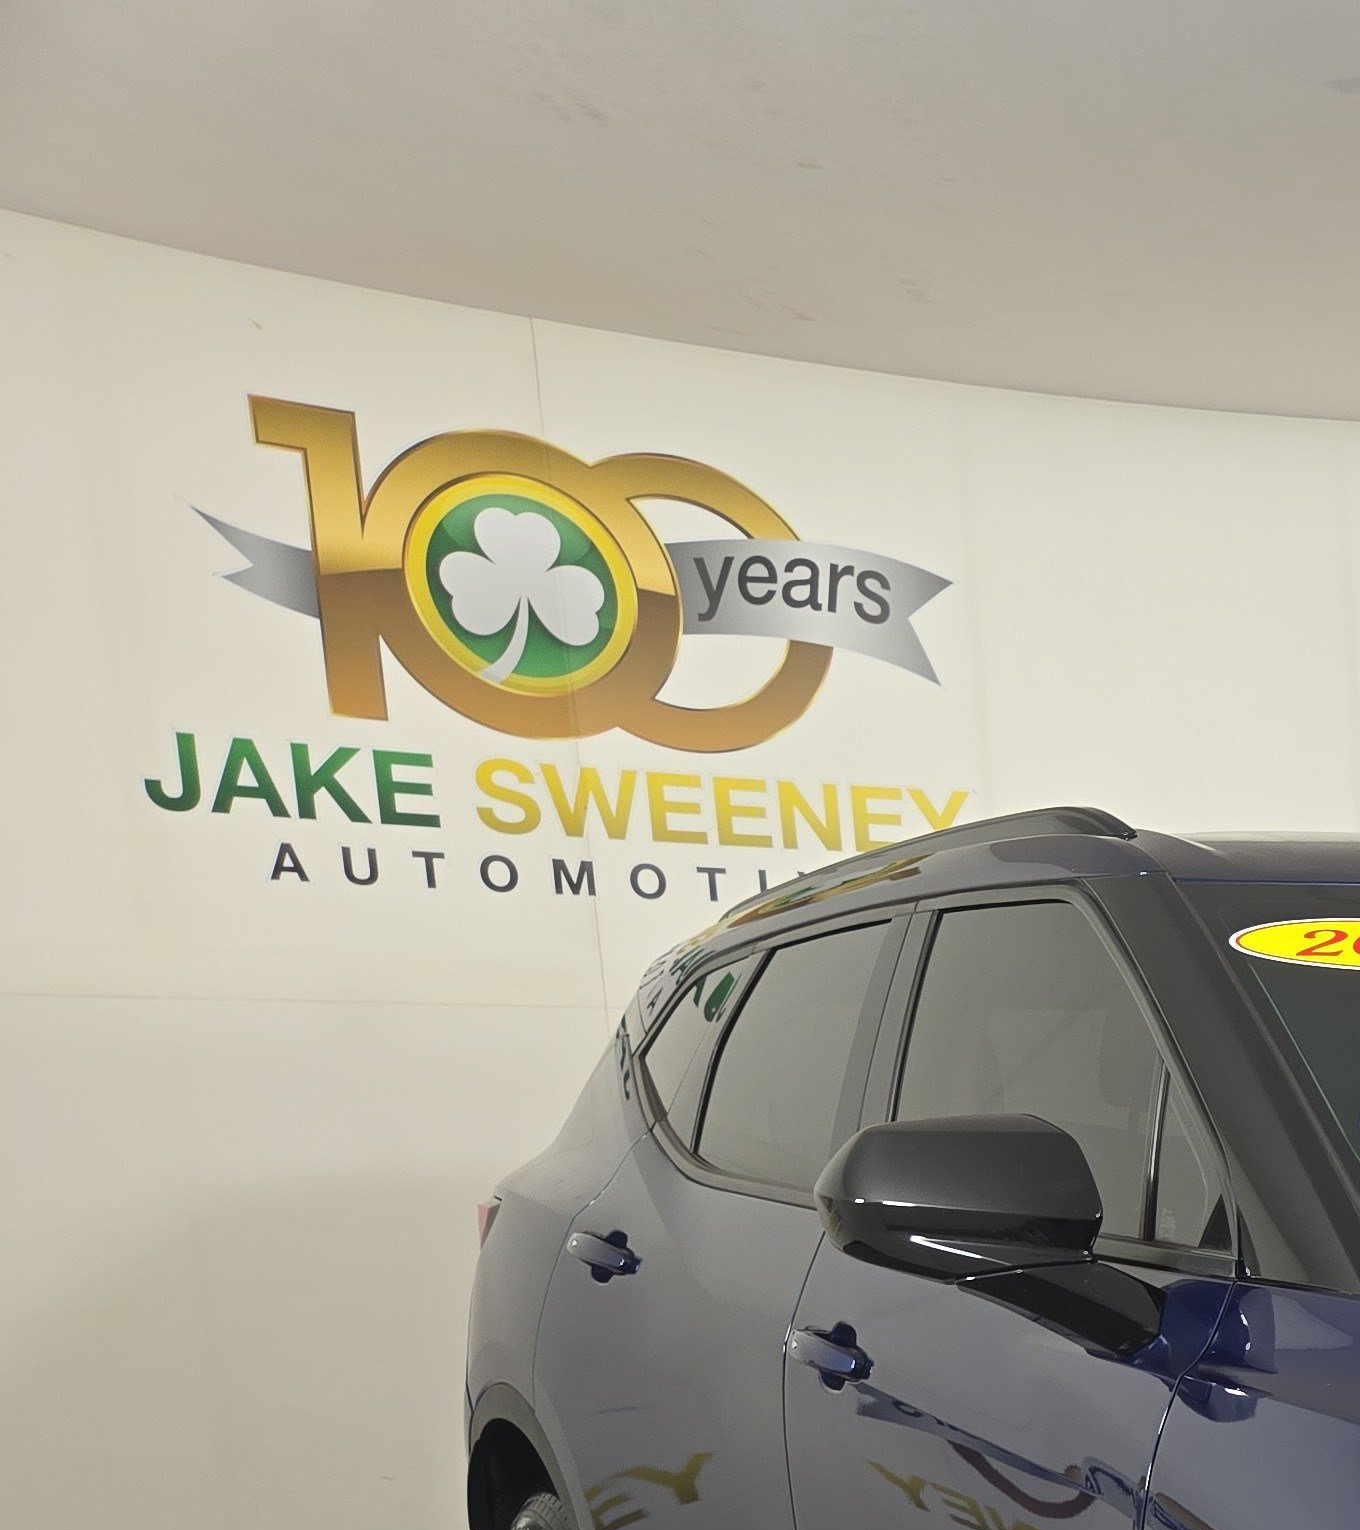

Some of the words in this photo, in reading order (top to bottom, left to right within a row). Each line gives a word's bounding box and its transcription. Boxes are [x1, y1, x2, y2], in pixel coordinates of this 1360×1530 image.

[247, 393, 834, 753] 100
[694, 552, 893, 625] years
[143, 731, 441, 829] JAKE
[475, 757, 970, 854] SWEENEY
[270, 841, 805, 903] AUTOMOTI
